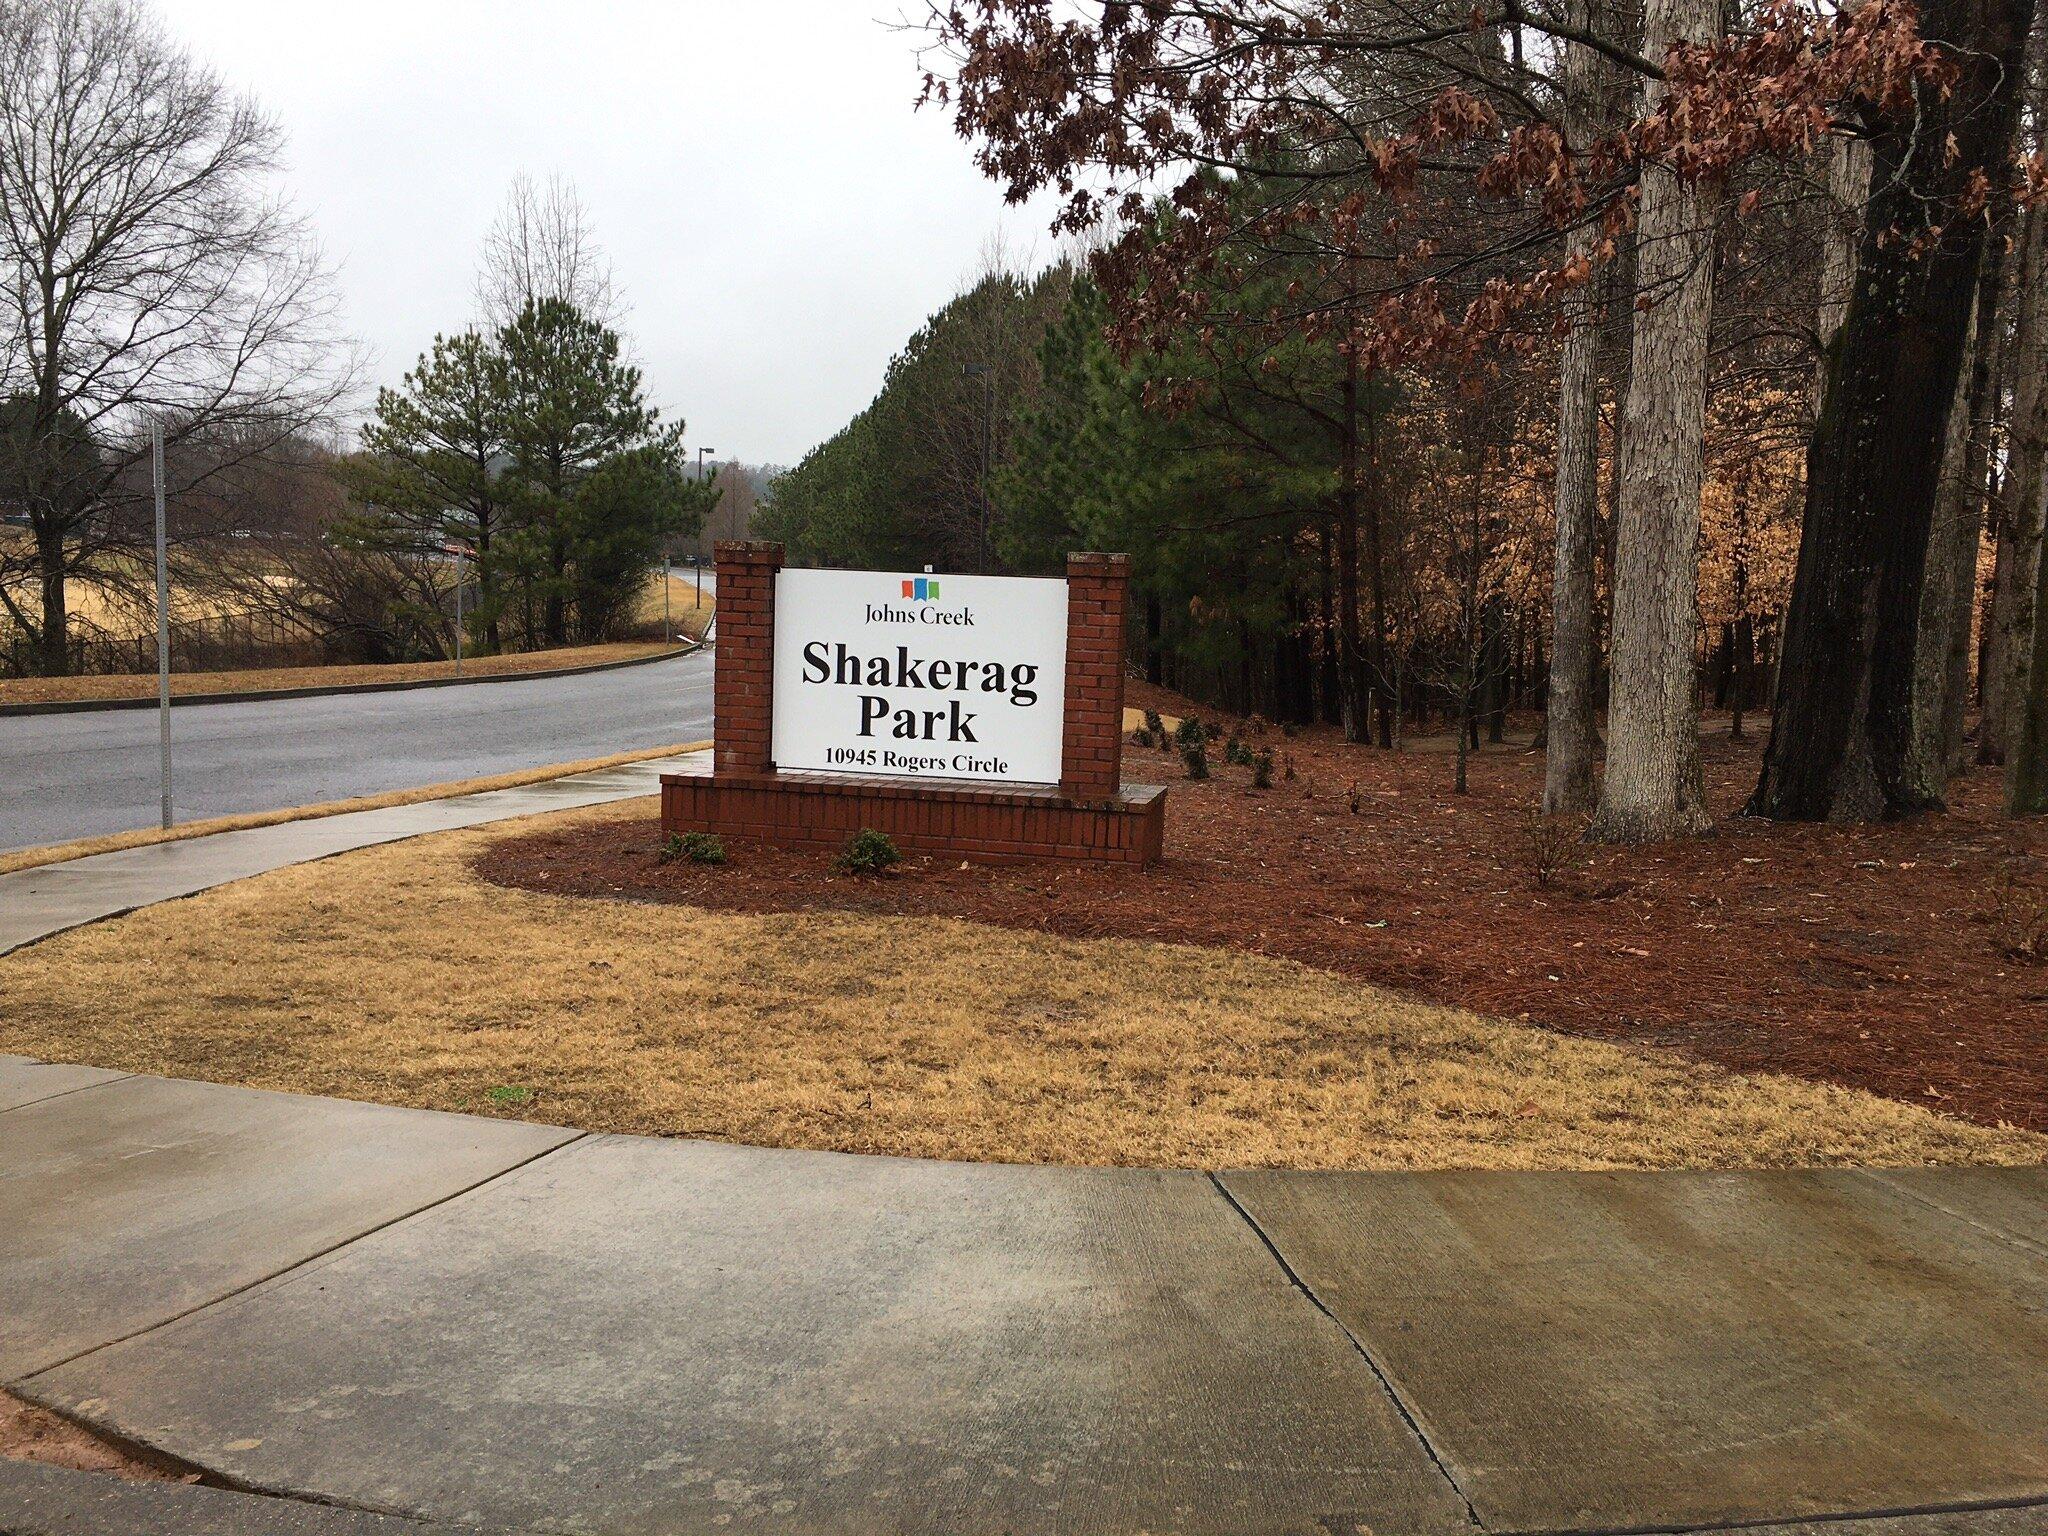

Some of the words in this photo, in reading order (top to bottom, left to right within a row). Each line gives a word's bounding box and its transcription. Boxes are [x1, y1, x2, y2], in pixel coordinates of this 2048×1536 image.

[865, 604, 916, 625] Johns
[920, 606, 975, 626] Creek
[802, 641, 1039, 707] Shakerag
[856, 695, 979, 743] Park
[825, 747, 877, 767] 10945
[883, 750, 946, 773] Rogers
[952, 755, 1008, 774] Circle
